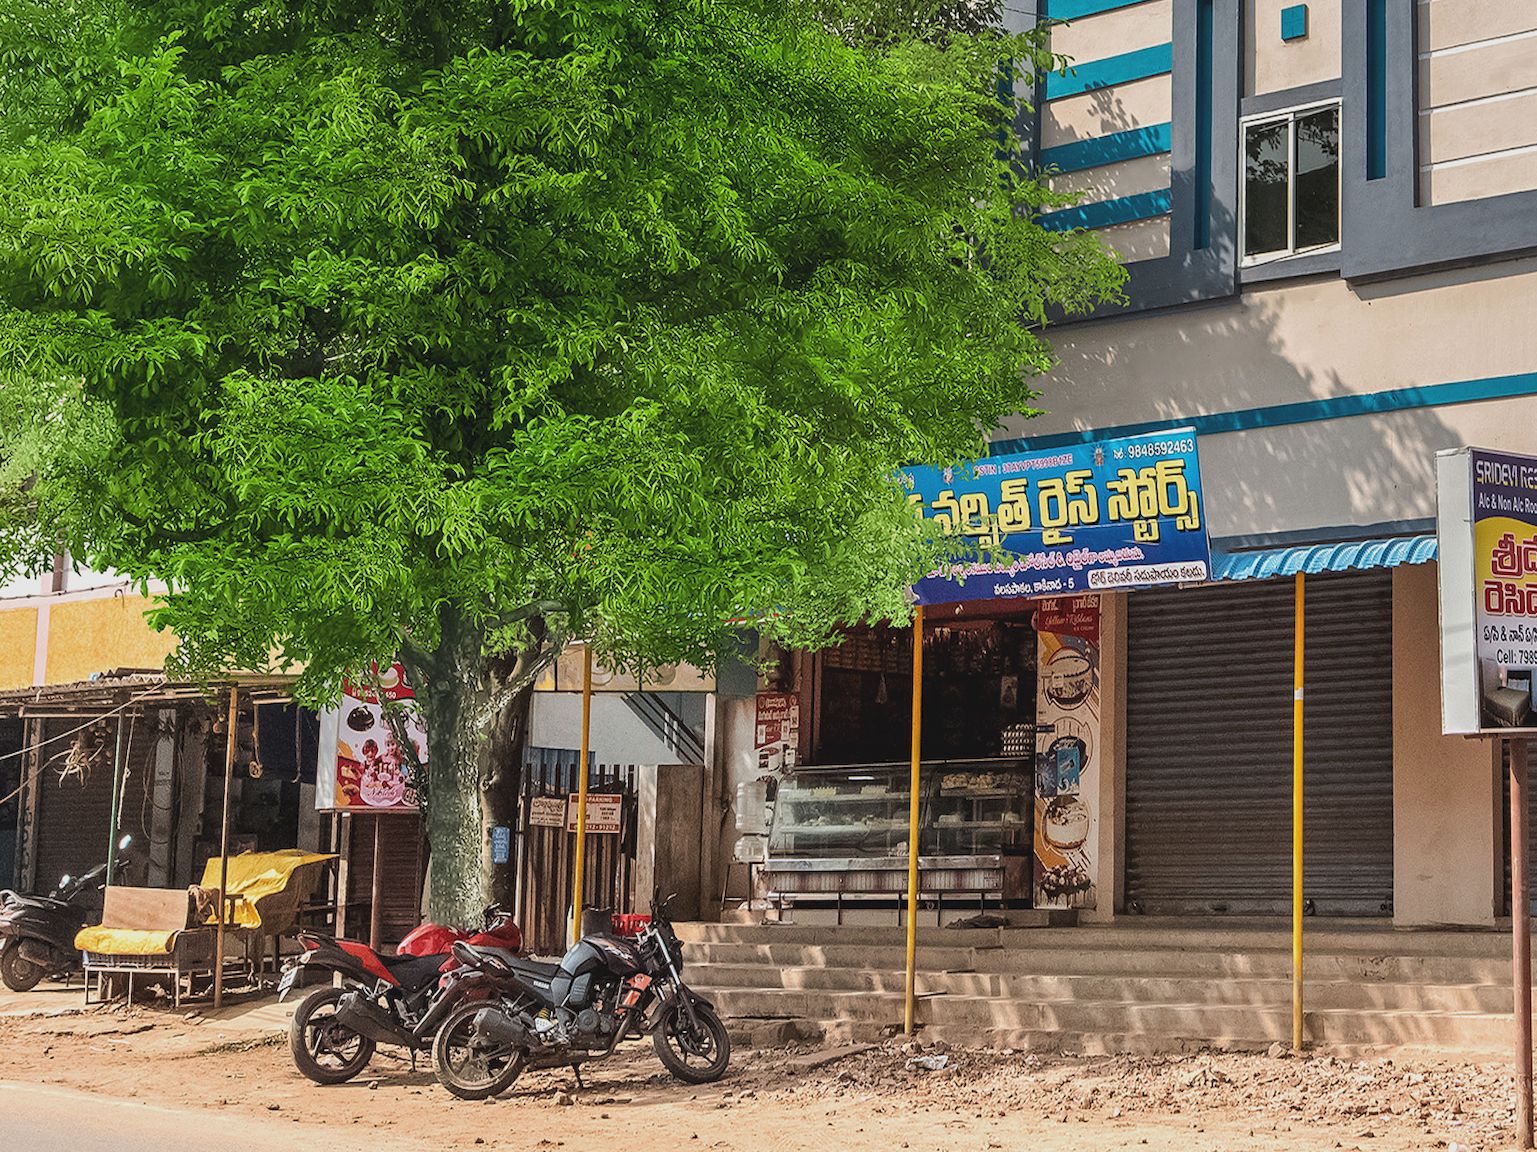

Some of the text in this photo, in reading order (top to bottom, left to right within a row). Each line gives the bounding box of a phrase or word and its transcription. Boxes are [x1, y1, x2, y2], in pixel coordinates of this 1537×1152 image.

[1127, 438, 1194, 459] 9848592463
[1476, 460, 1518, 488] SRIDEVI
[1491, 494, 1498, 509] &
[1498, 495, 1512, 511] Non
[1496, 649, 1517, 664] Cell:
